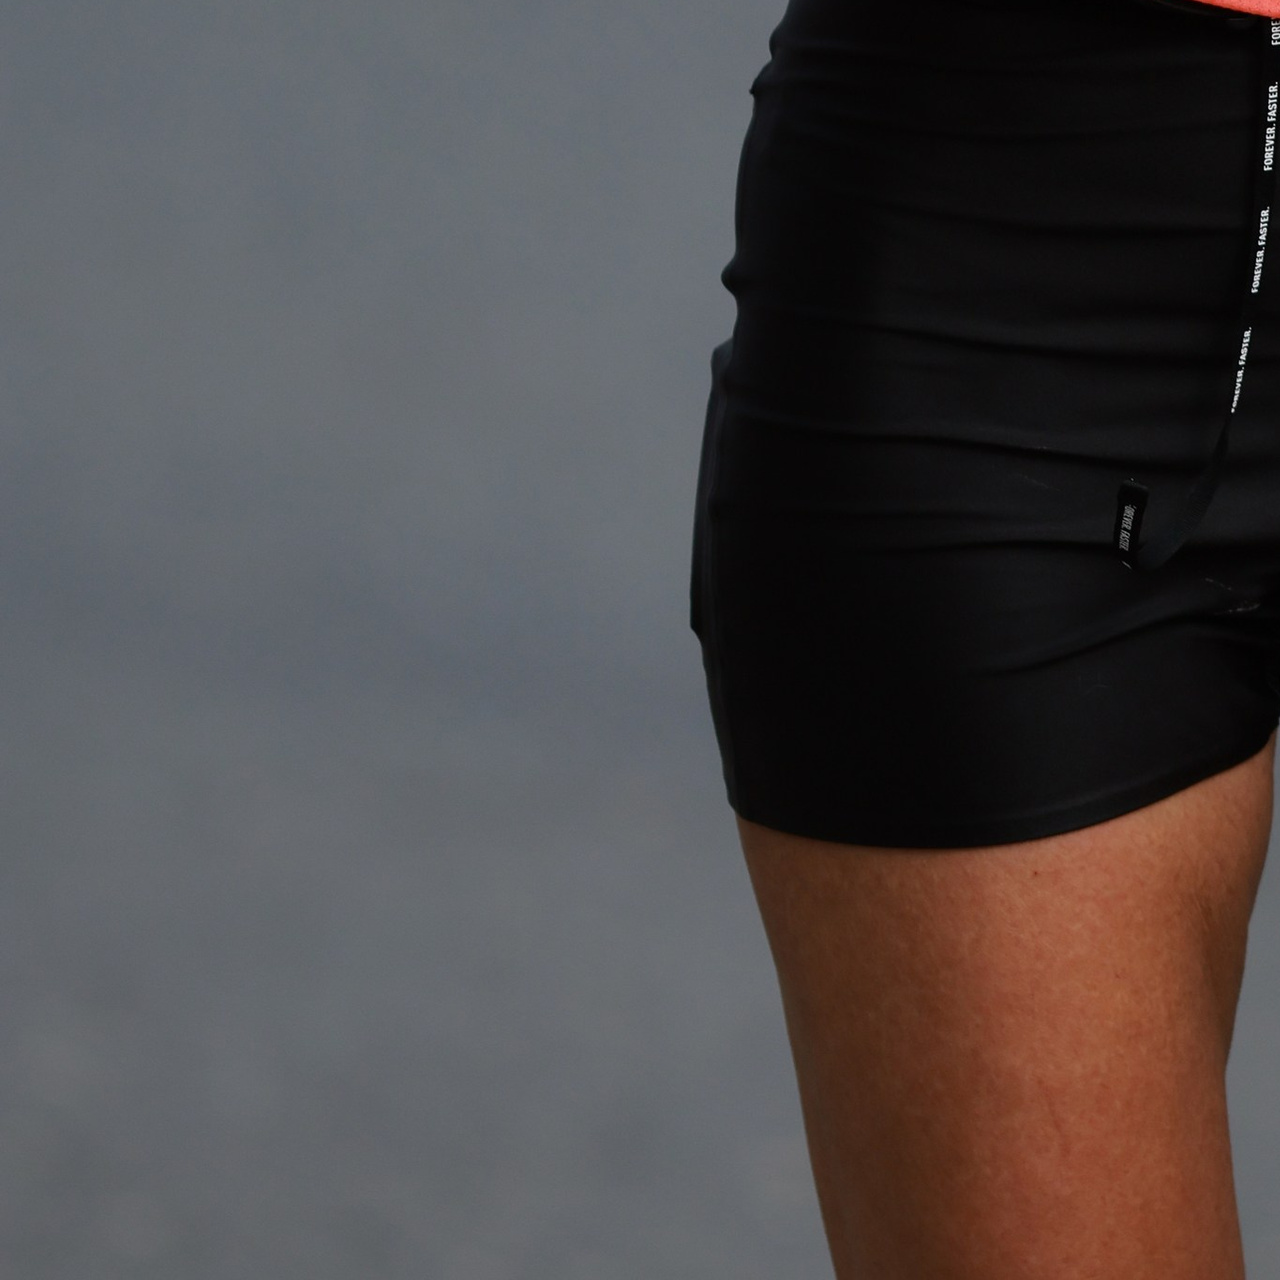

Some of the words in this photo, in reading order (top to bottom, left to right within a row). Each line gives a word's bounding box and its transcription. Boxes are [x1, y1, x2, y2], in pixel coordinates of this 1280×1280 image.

[1271, 18, 1280, 45] FORE
[1267, 81, 1279, 122] FASTER.
[1263, 123, 1276, 171] FOREVER.
[1257, 206, 1270, 246] FASTER.
[1251, 246, 1266, 293] FOREVER.
[1238, 326, 1252, 366] FASTER.
